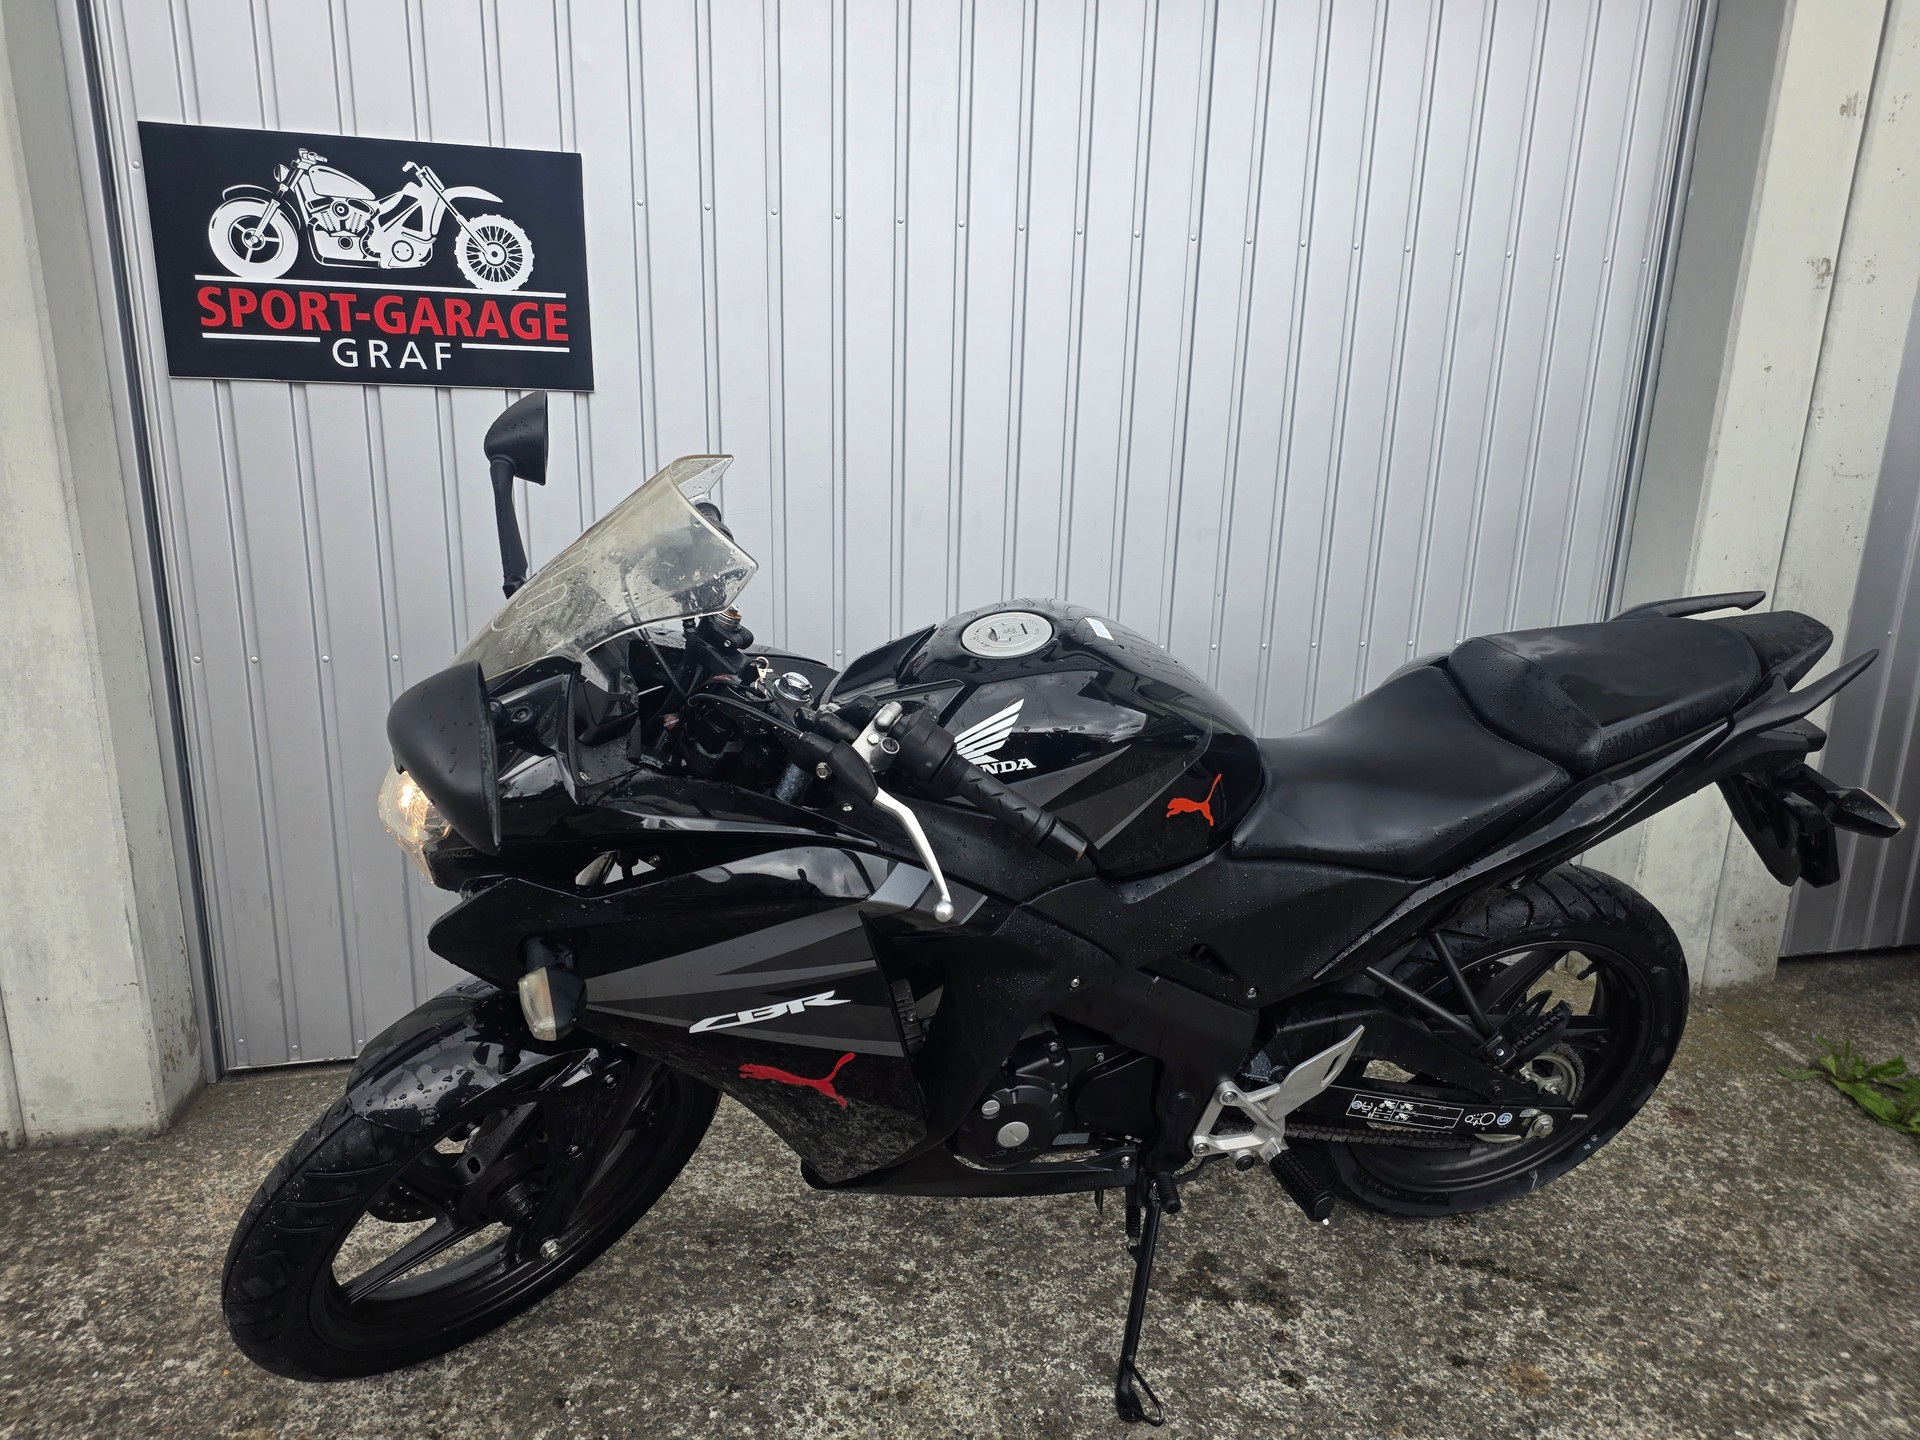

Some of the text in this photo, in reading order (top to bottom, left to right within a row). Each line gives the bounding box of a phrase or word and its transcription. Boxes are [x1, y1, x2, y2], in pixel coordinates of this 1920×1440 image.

[197, 287, 569, 341] SPORT-GARAGE
[331, 338, 453, 371] GRAF
[980, 758, 1037, 775] NDA
[689, 990, 851, 1033] CBR
